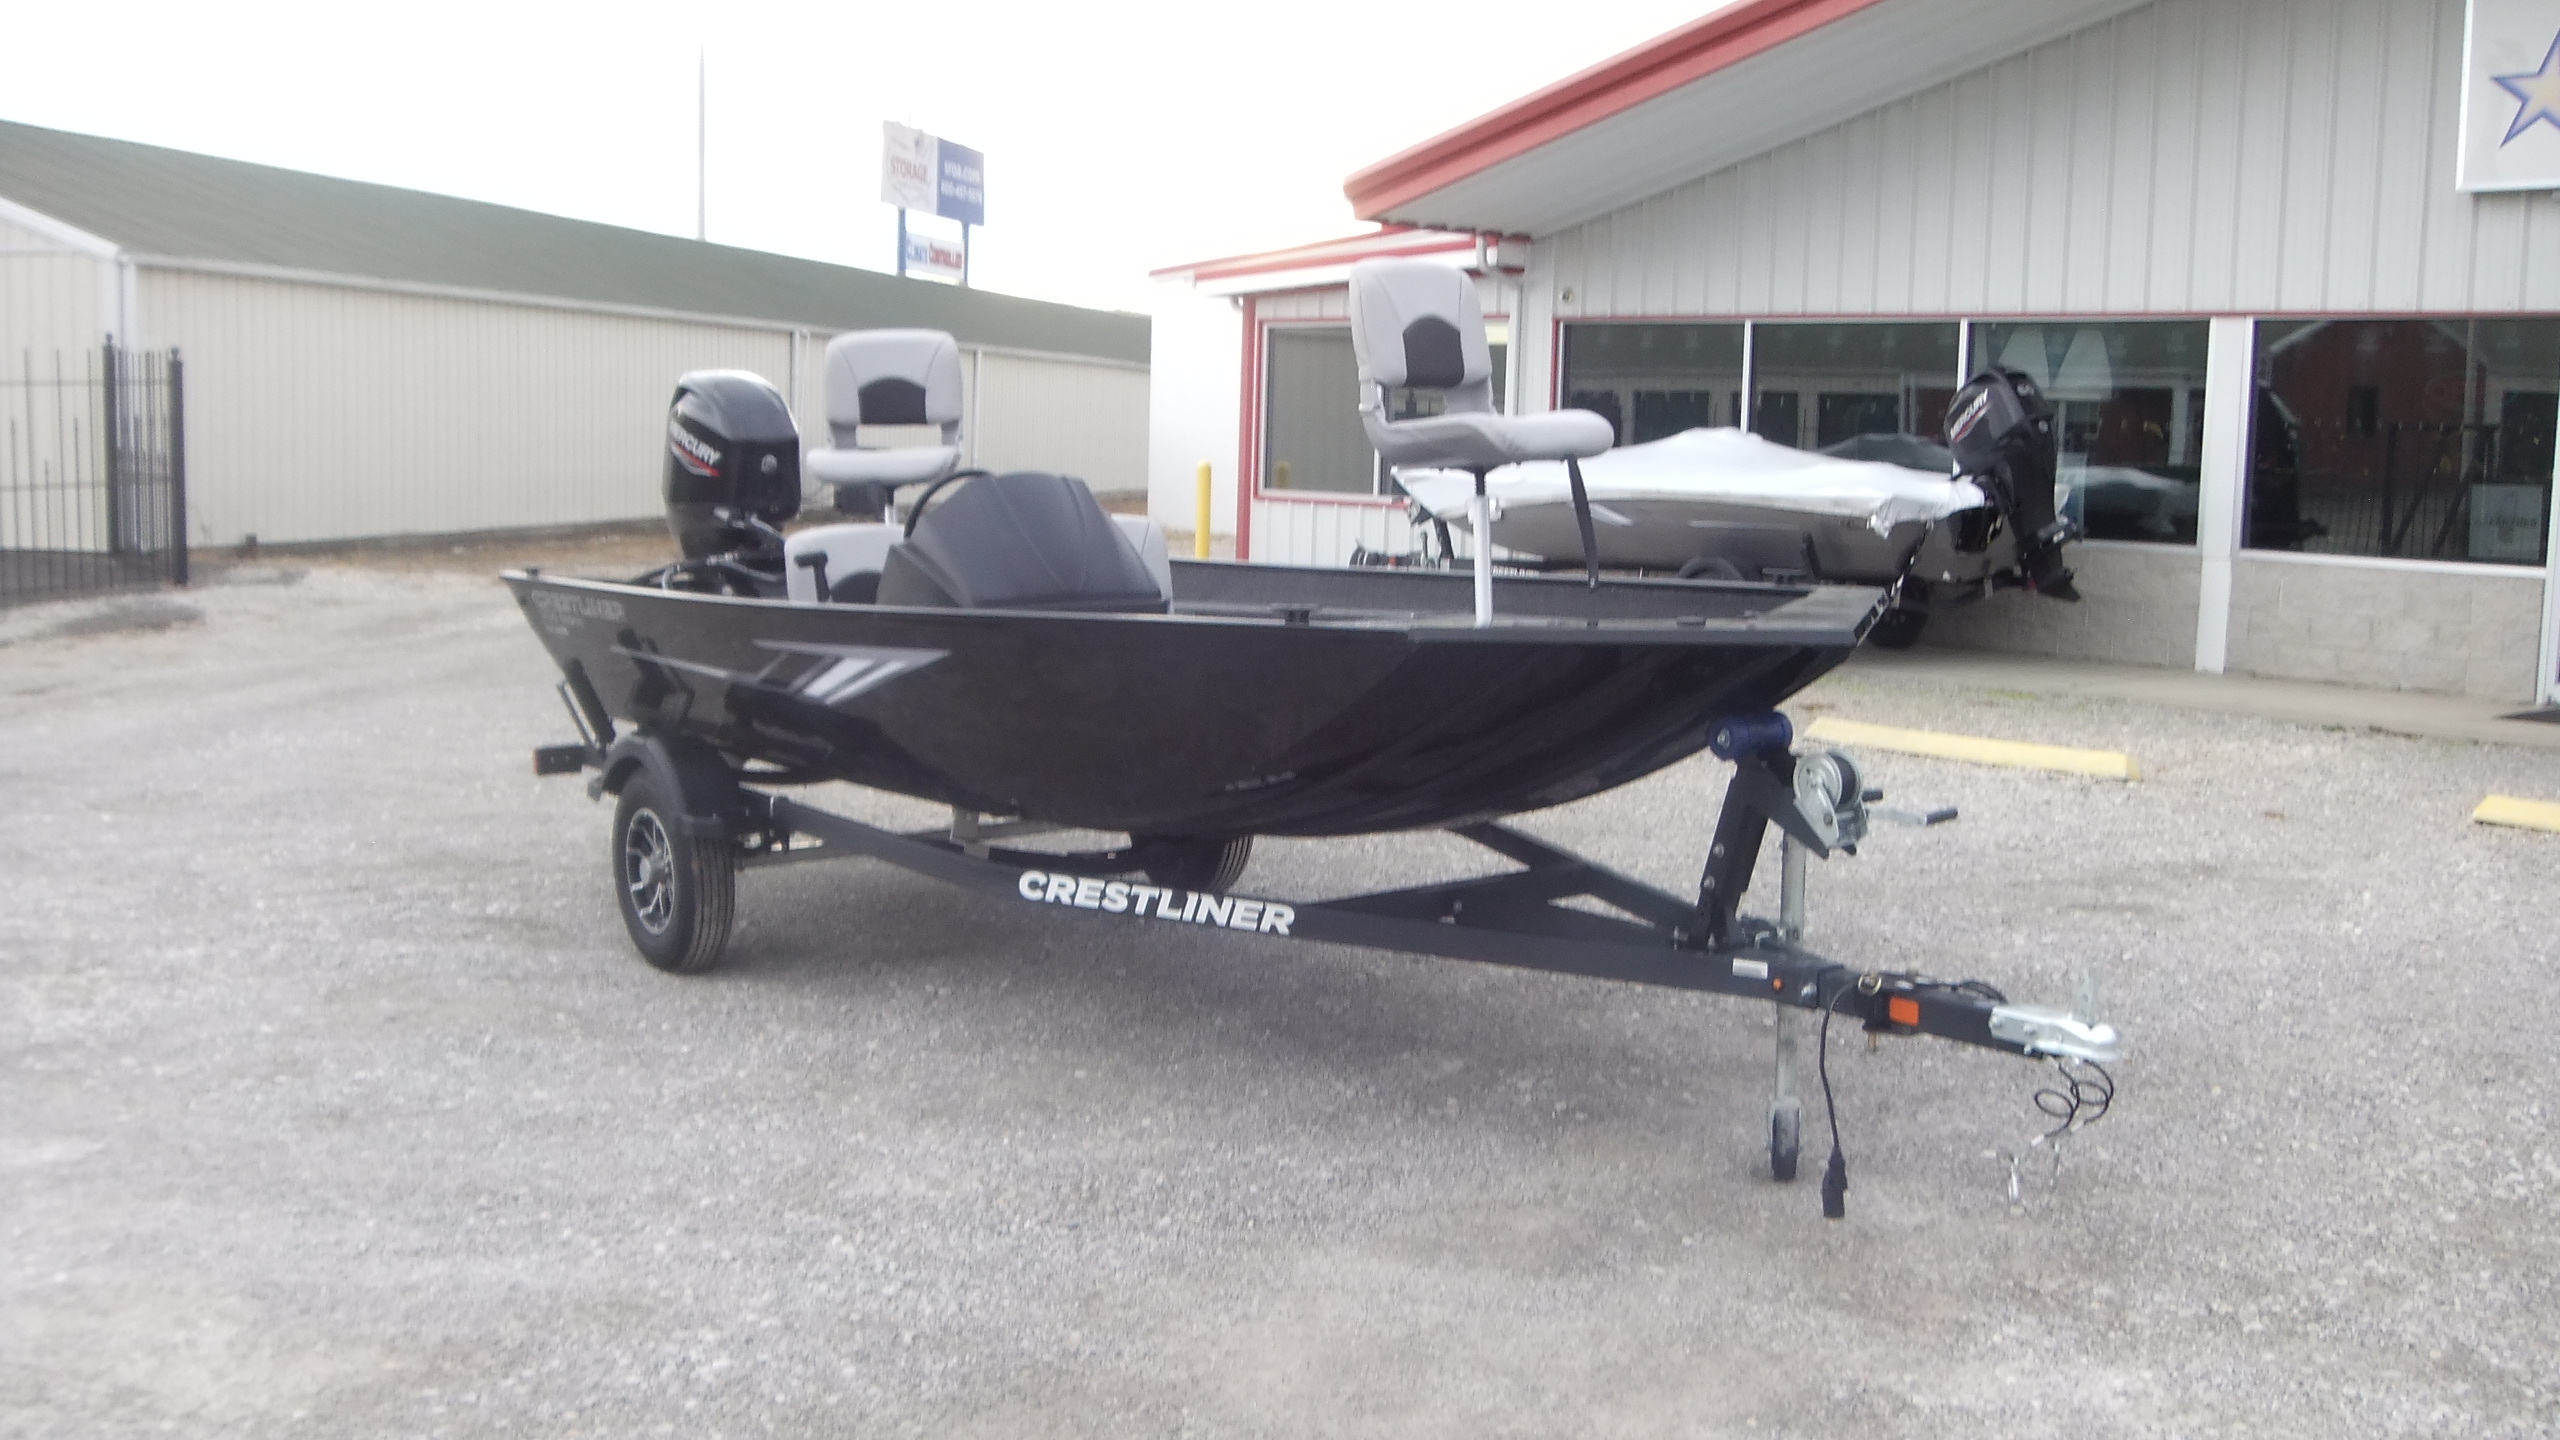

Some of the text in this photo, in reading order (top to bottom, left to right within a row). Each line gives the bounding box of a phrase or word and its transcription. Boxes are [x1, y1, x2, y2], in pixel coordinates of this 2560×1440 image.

[890, 156, 928, 184] STORAGE
[1950, 388, 1989, 441] MERCURY
[1018, 870, 1296, 936] CRESTLINER
